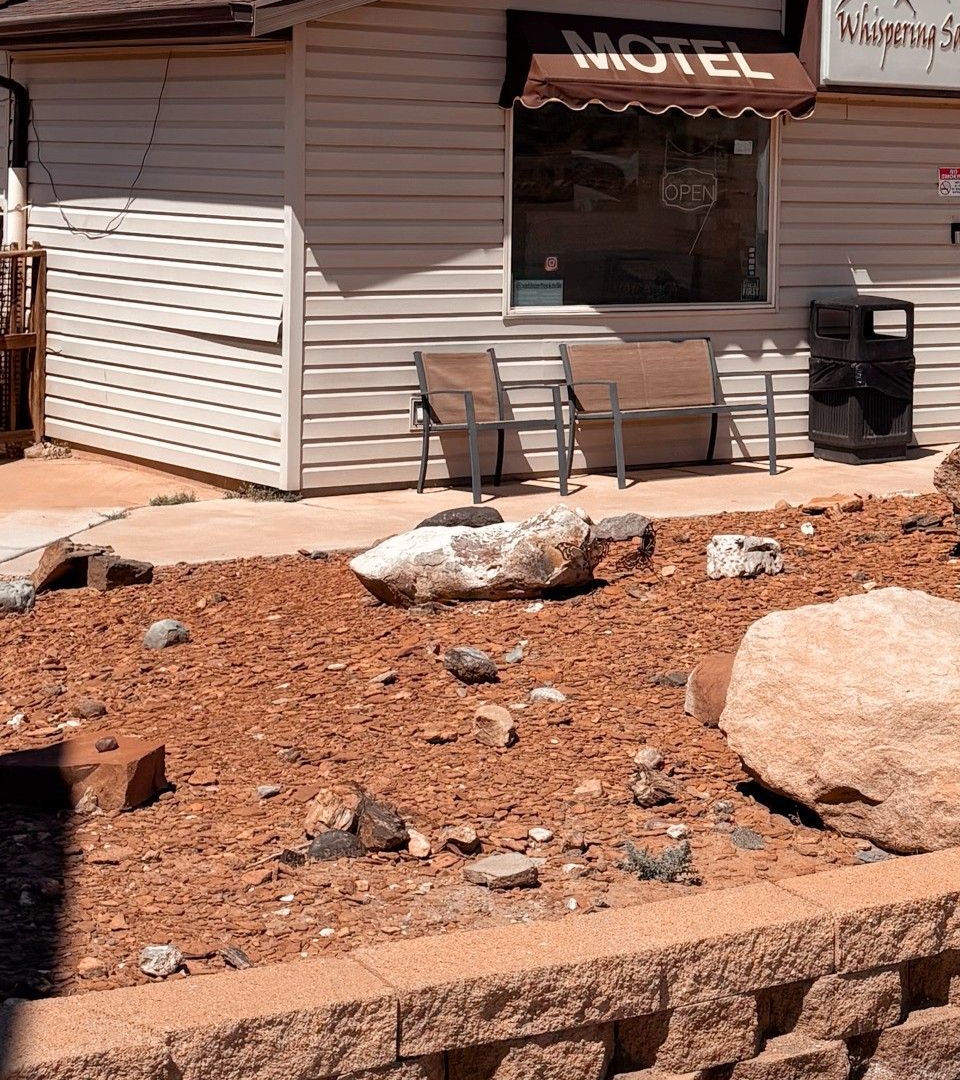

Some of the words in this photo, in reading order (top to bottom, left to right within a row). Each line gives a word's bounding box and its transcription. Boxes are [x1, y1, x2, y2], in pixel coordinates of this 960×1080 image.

[560, 29, 775, 81] MOTEL
[836, 3, 937, 73] Whispering
[663, 183, 716, 202] OPEN
